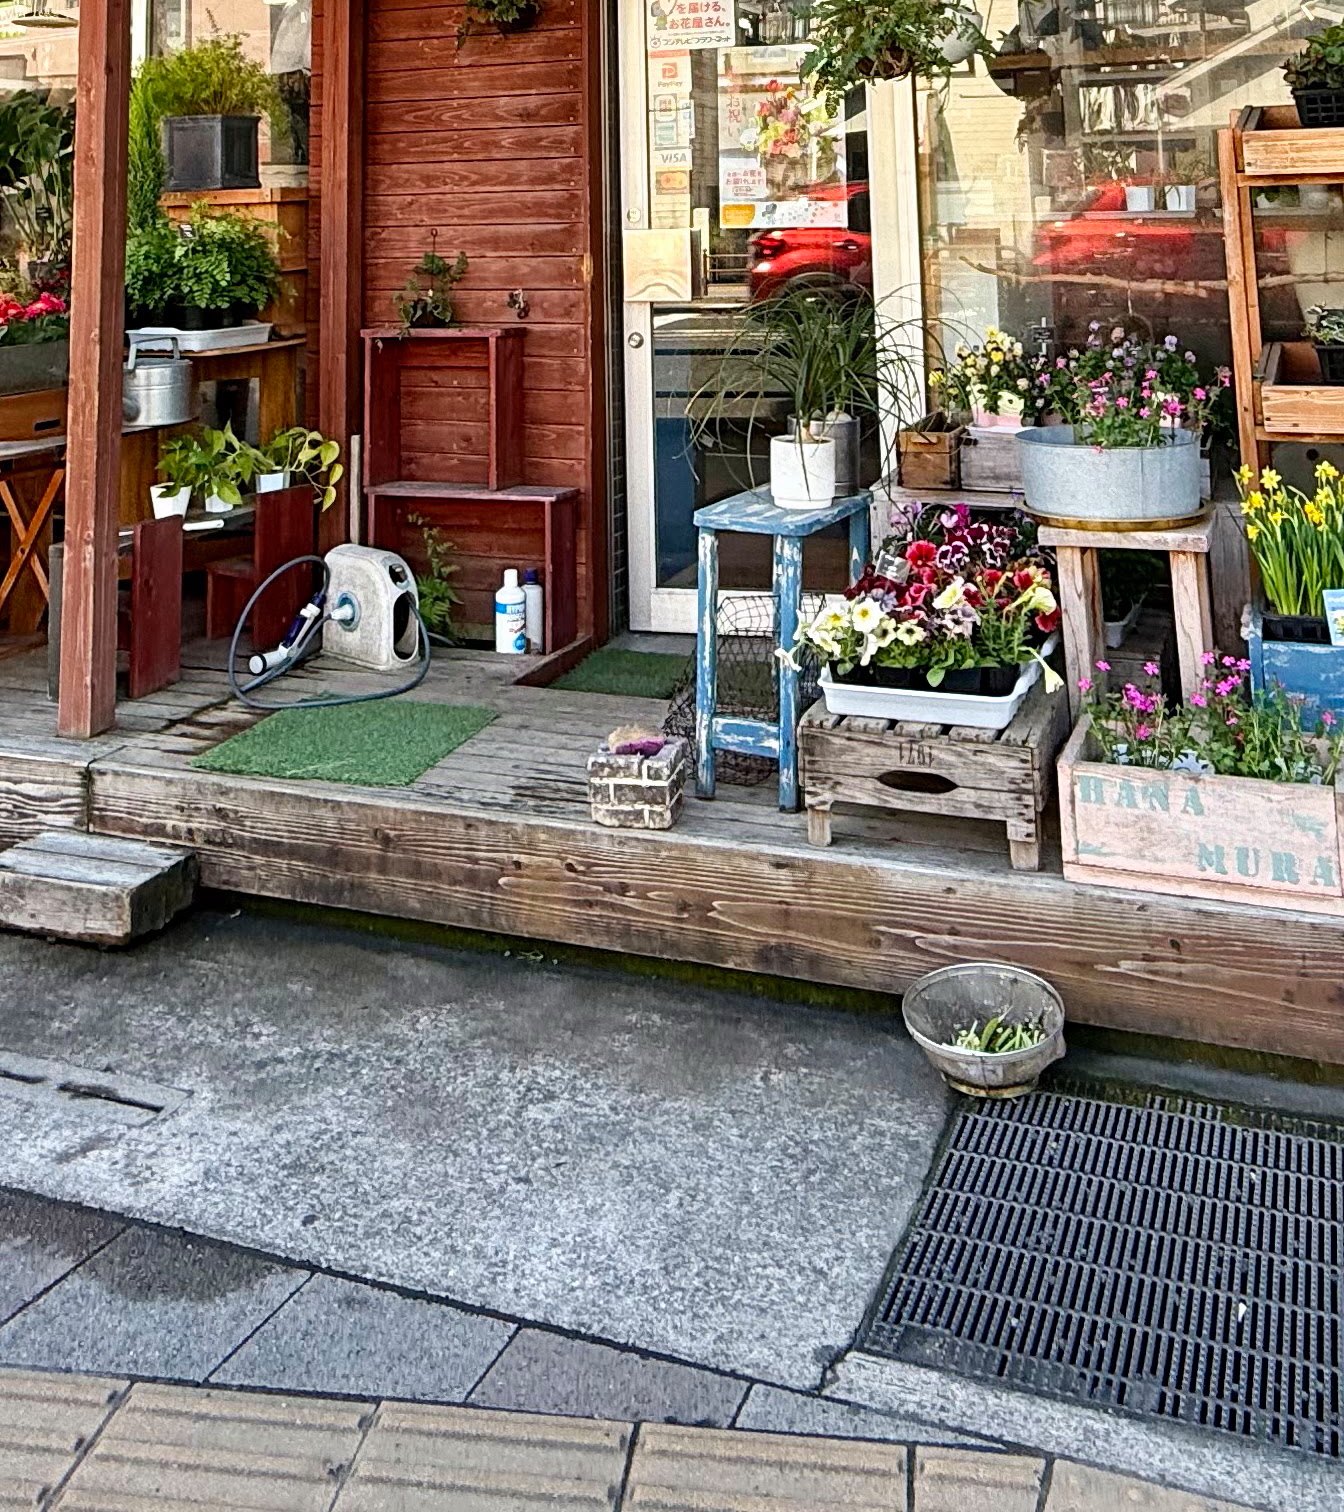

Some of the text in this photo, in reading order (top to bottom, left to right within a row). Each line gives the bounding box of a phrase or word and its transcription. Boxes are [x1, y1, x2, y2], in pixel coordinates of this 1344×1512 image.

[660, 152, 687, 164] VISA
[1077, 775, 1205, 817] HANA
[1196, 842, 1338, 888] MURA
